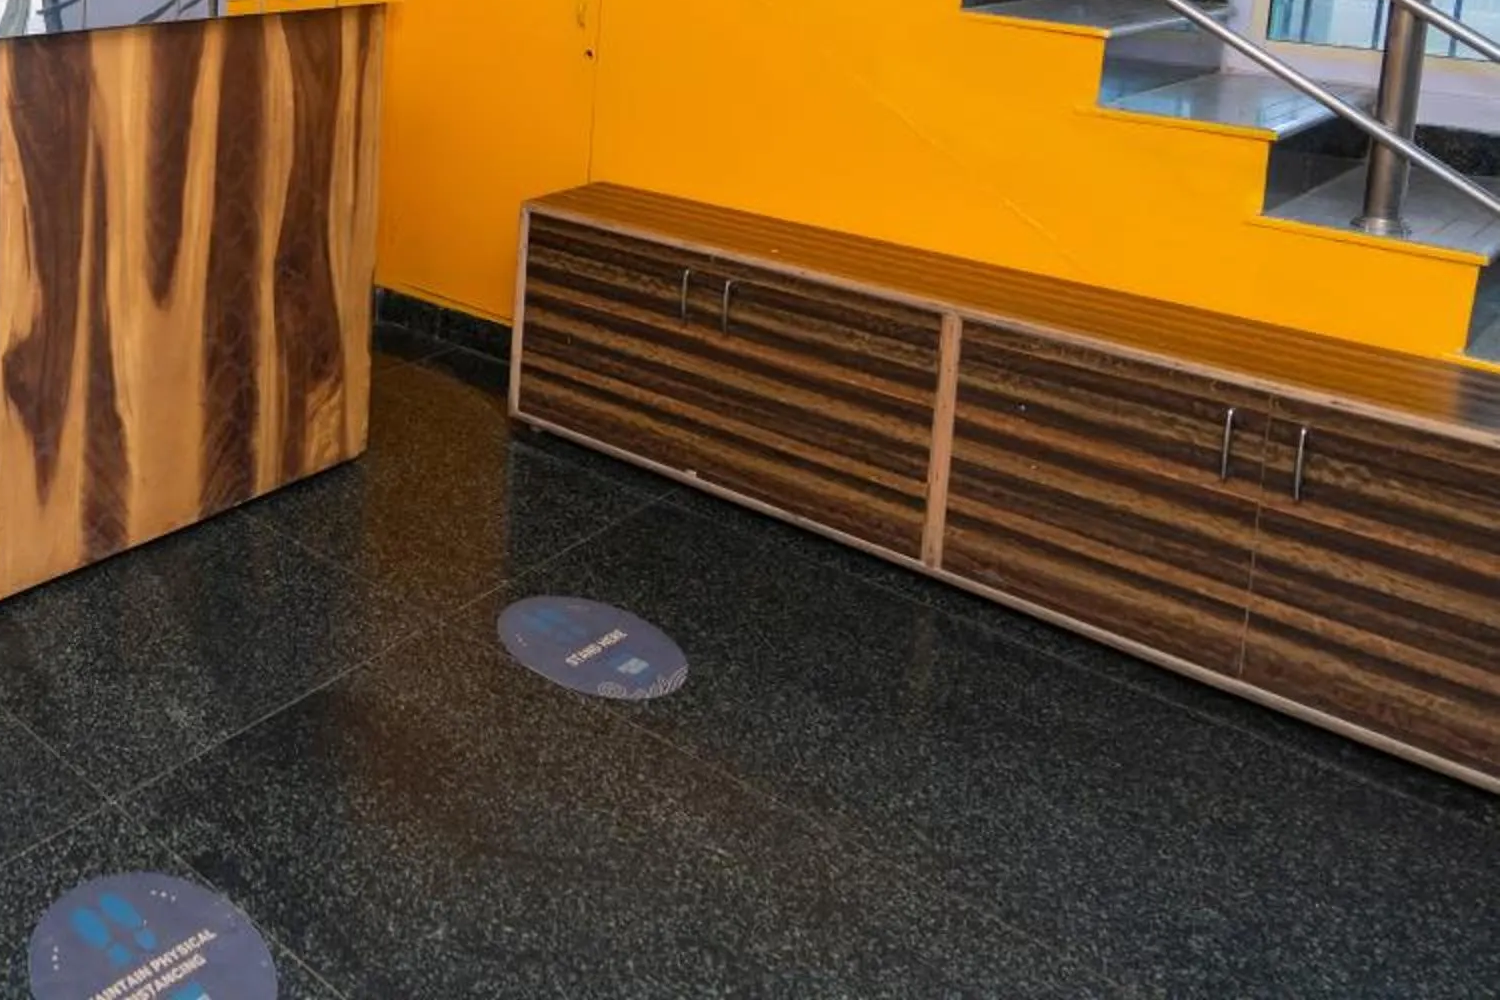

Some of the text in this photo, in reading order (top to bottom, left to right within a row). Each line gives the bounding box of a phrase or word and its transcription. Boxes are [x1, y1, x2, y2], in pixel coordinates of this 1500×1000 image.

[88, 929, 218, 1000] AINTAIN PHYSICAL
[124, 953, 207, 1000] ISTANCING
